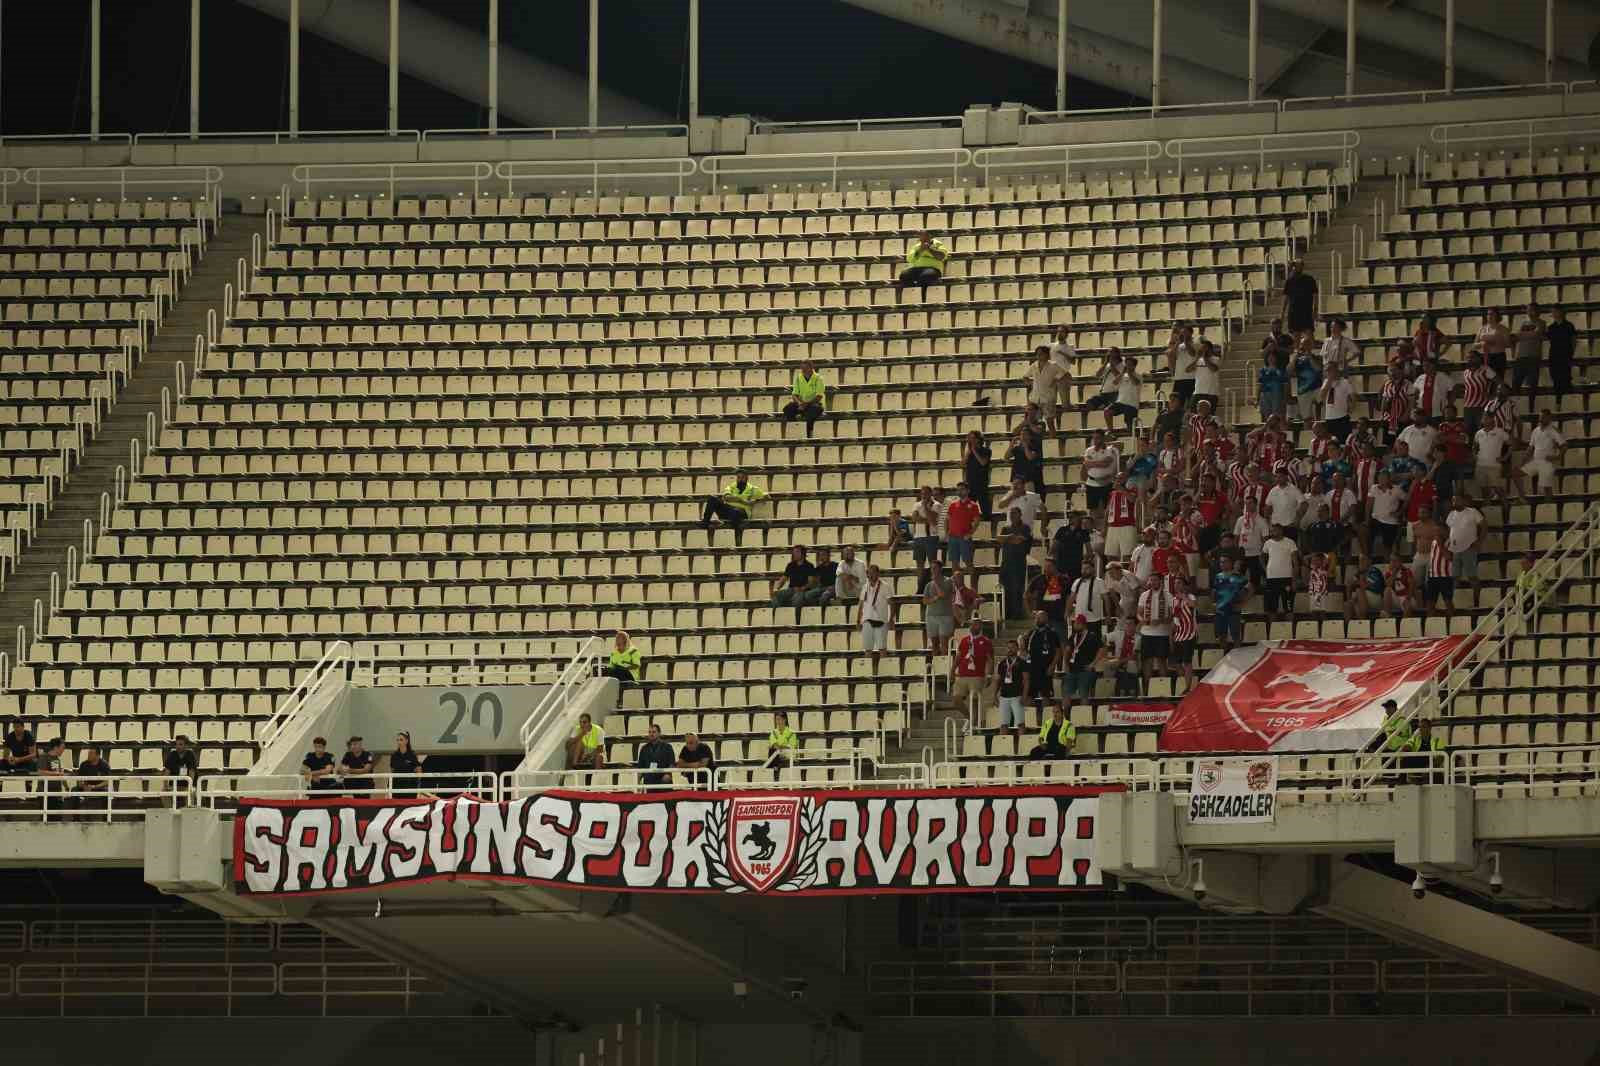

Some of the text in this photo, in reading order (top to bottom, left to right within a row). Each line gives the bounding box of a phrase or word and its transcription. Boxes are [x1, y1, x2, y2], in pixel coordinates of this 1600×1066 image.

[438, 691, 503, 744] 20
[1266, 717, 1307, 727] 1965
[738, 804, 792, 816] SAMSUNSPOR
[1191, 793, 1273, 821] ŞEHZADELER
[244, 796, 1102, 893] SAMSUNSPOR AVRUPA
[751, 863, 771, 875] 1965
